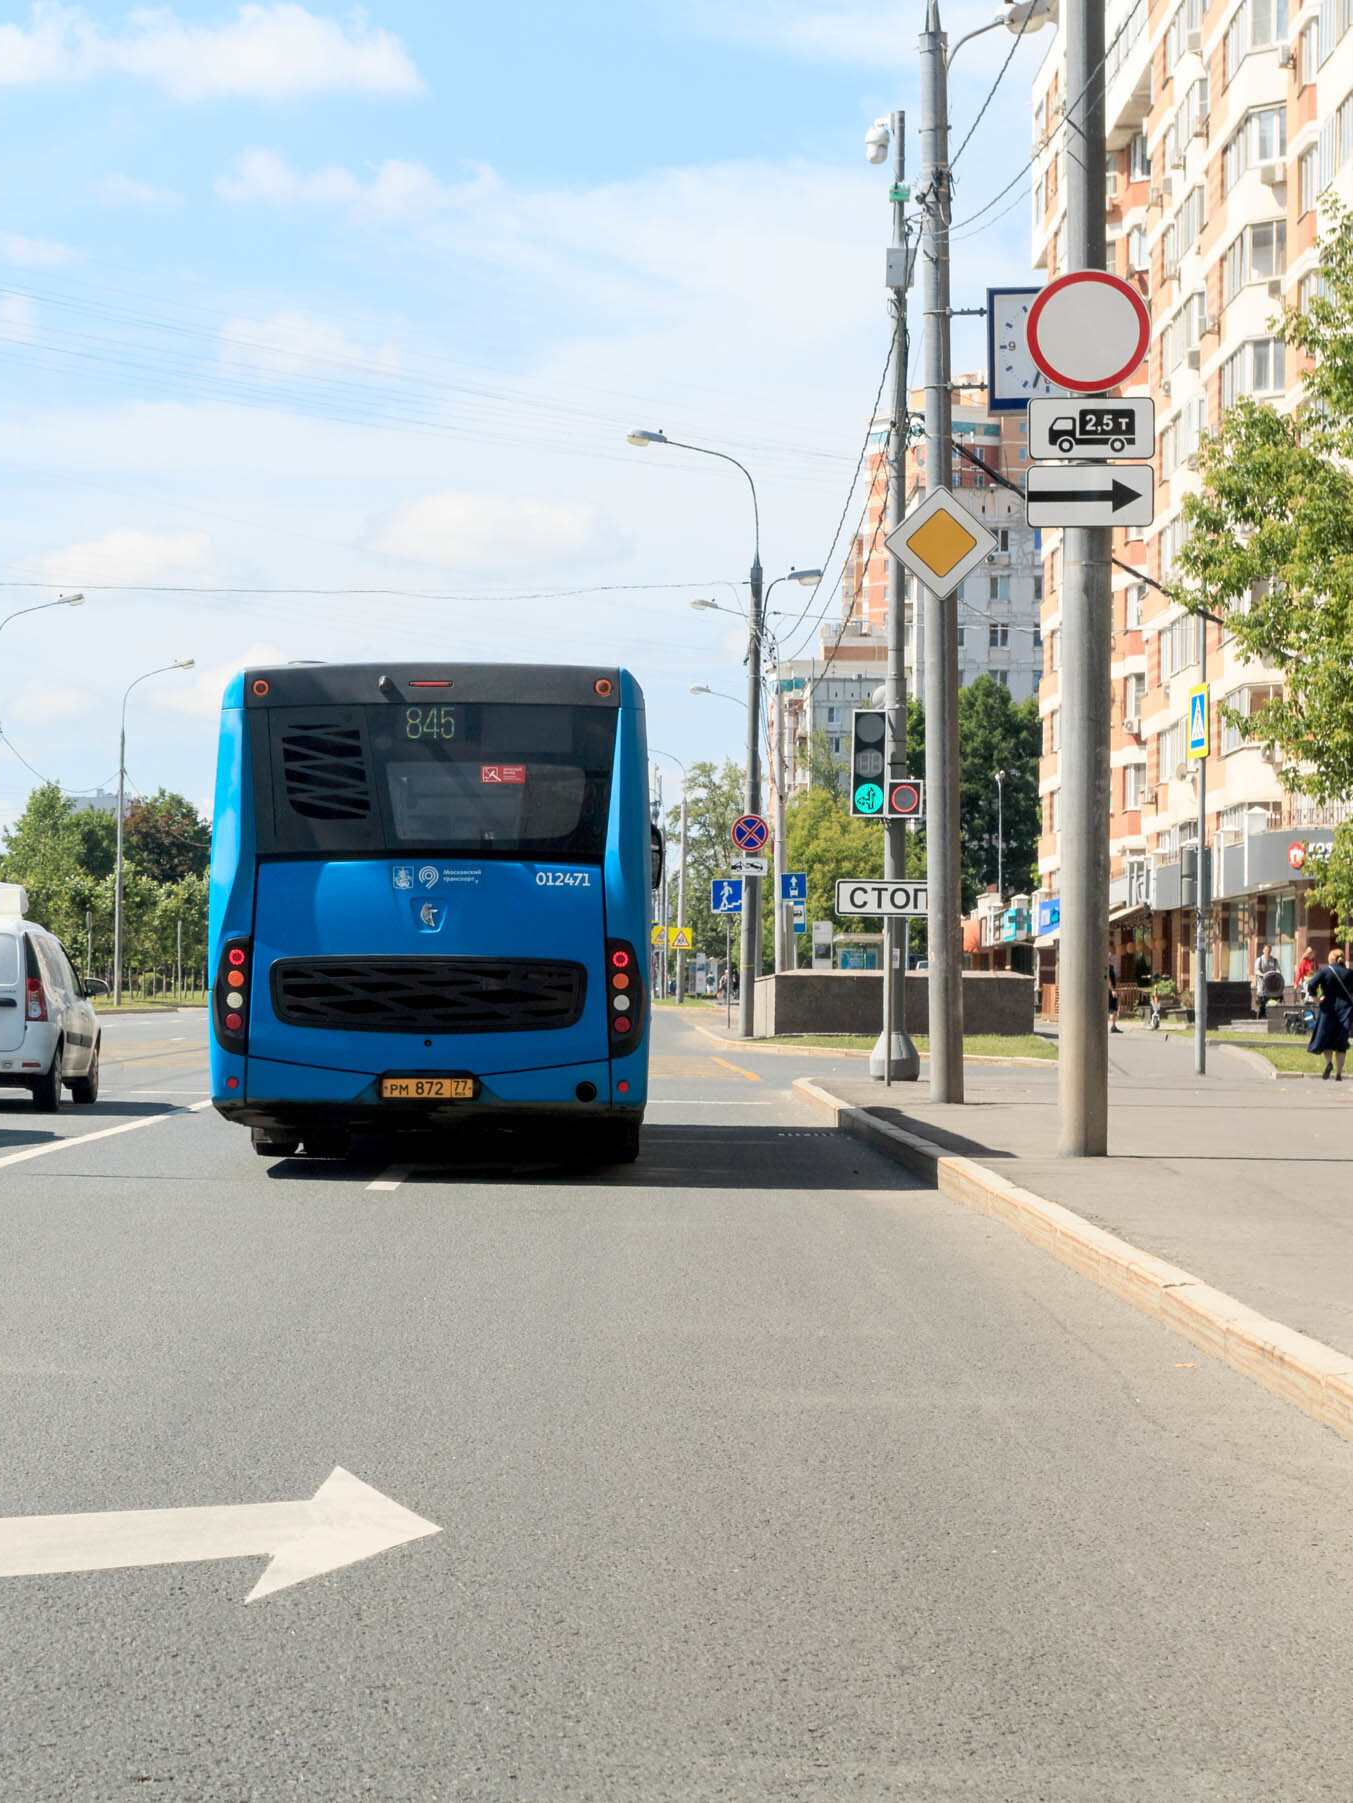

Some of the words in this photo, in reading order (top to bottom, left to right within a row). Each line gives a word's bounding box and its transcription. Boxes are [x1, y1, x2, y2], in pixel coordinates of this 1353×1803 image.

[1008, 341, 1016, 351] 9
[1085, 414, 1113, 433] 2,5
[406, 706, 455, 739] 845
[535, 871, 591, 887] 012471
[849, 886, 928, 910] СТОП
[390, 1084, 409, 1096] РМ
[415, 1081, 444, 1096] 872
[453, 1080, 468, 1092] 77
